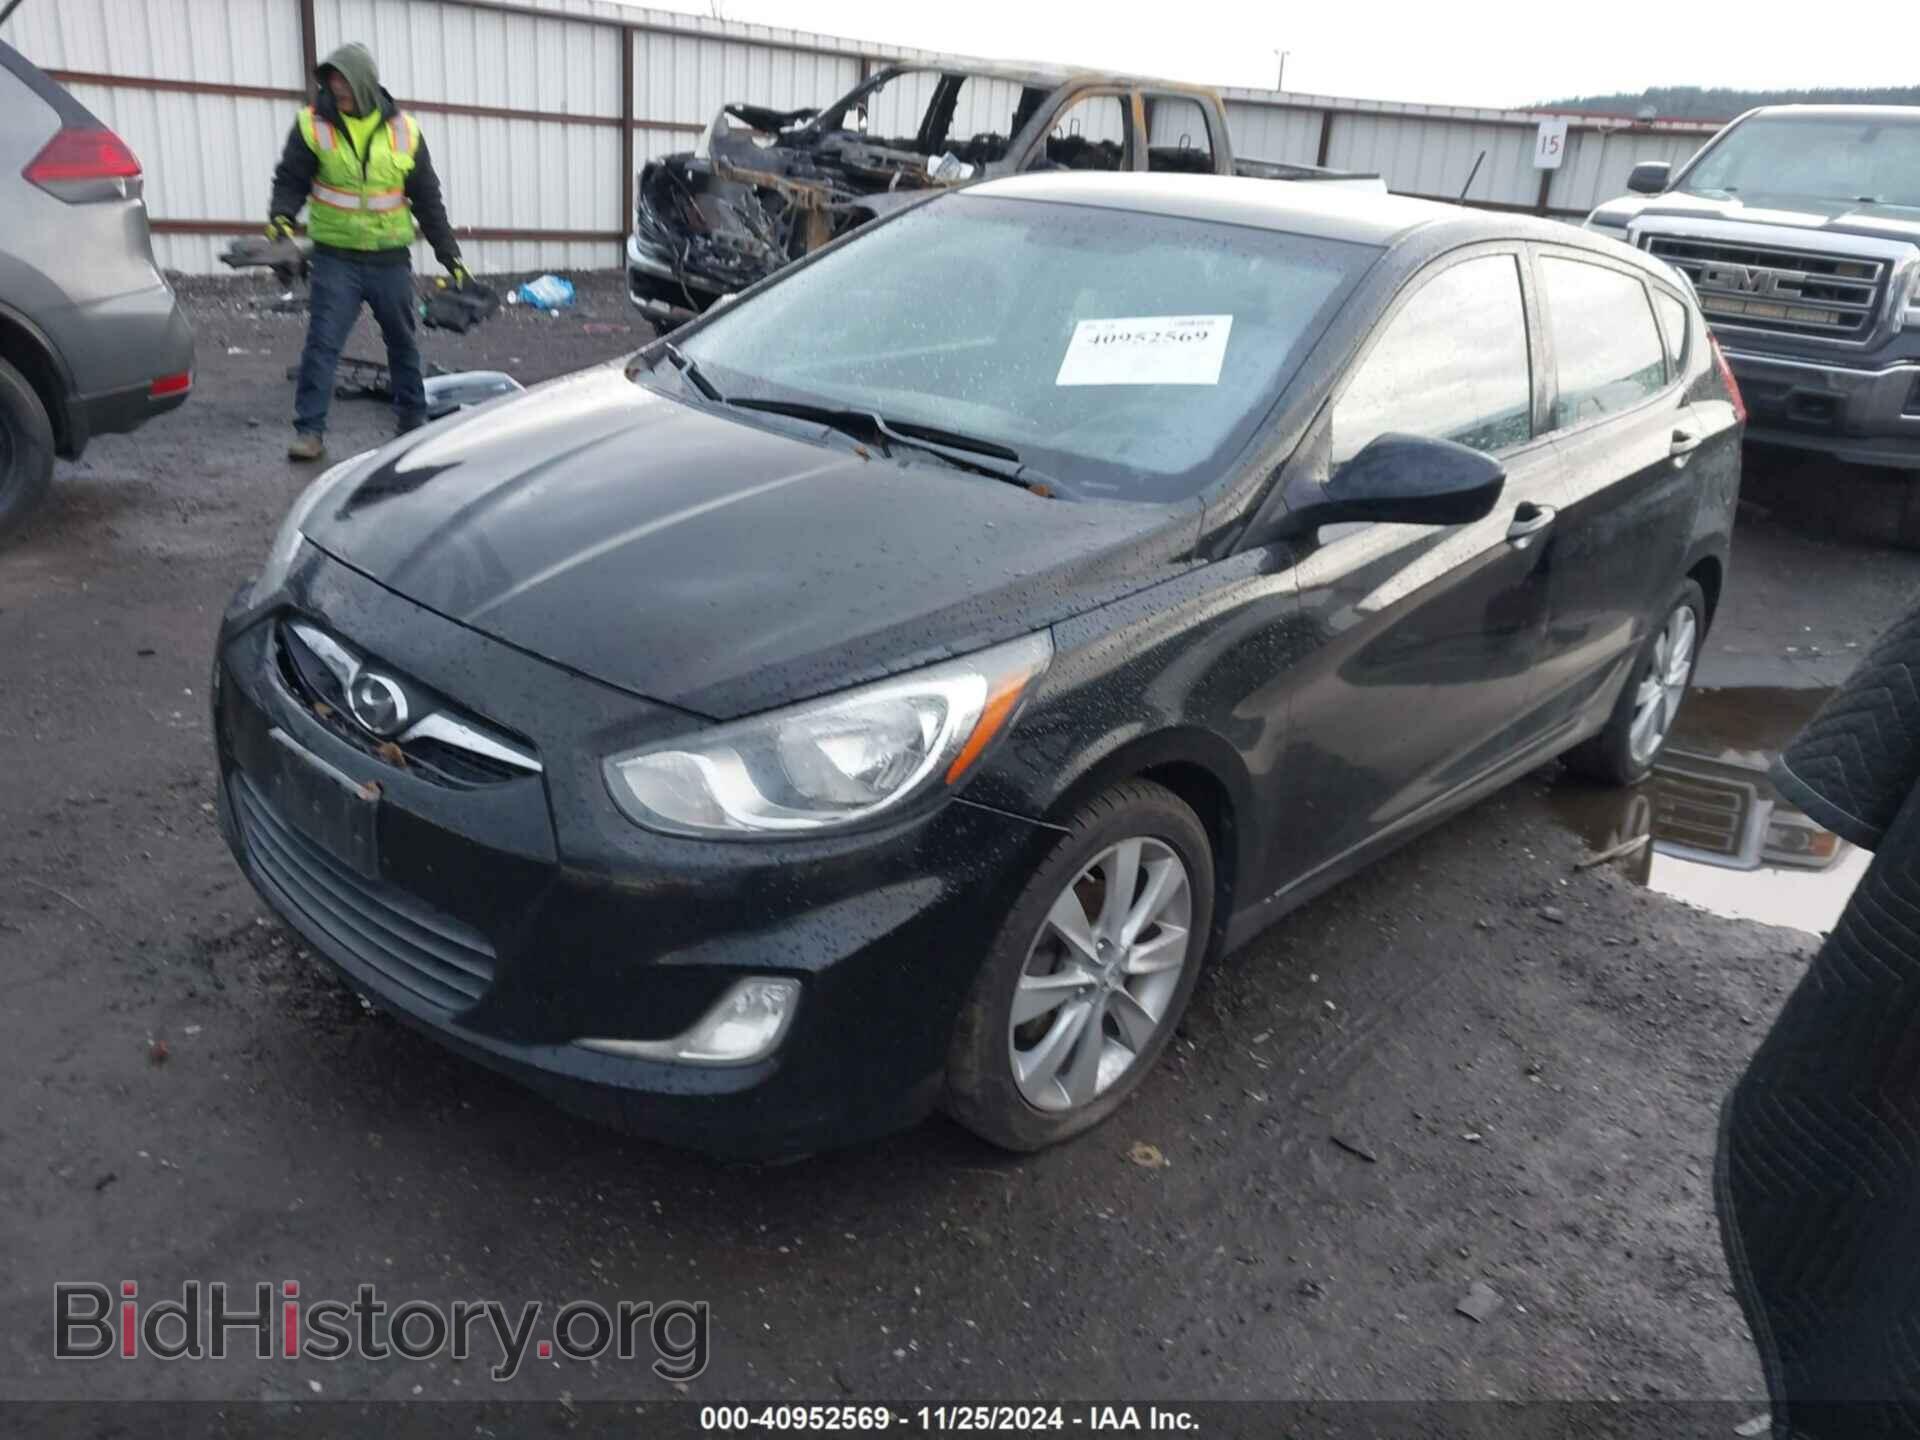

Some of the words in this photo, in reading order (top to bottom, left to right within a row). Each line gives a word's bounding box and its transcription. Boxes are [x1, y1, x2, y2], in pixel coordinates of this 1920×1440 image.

[1541, 135, 1560, 154] 15
[1701, 260, 1806, 298] GMC
[1086, 329, 1209, 345] 40952569
